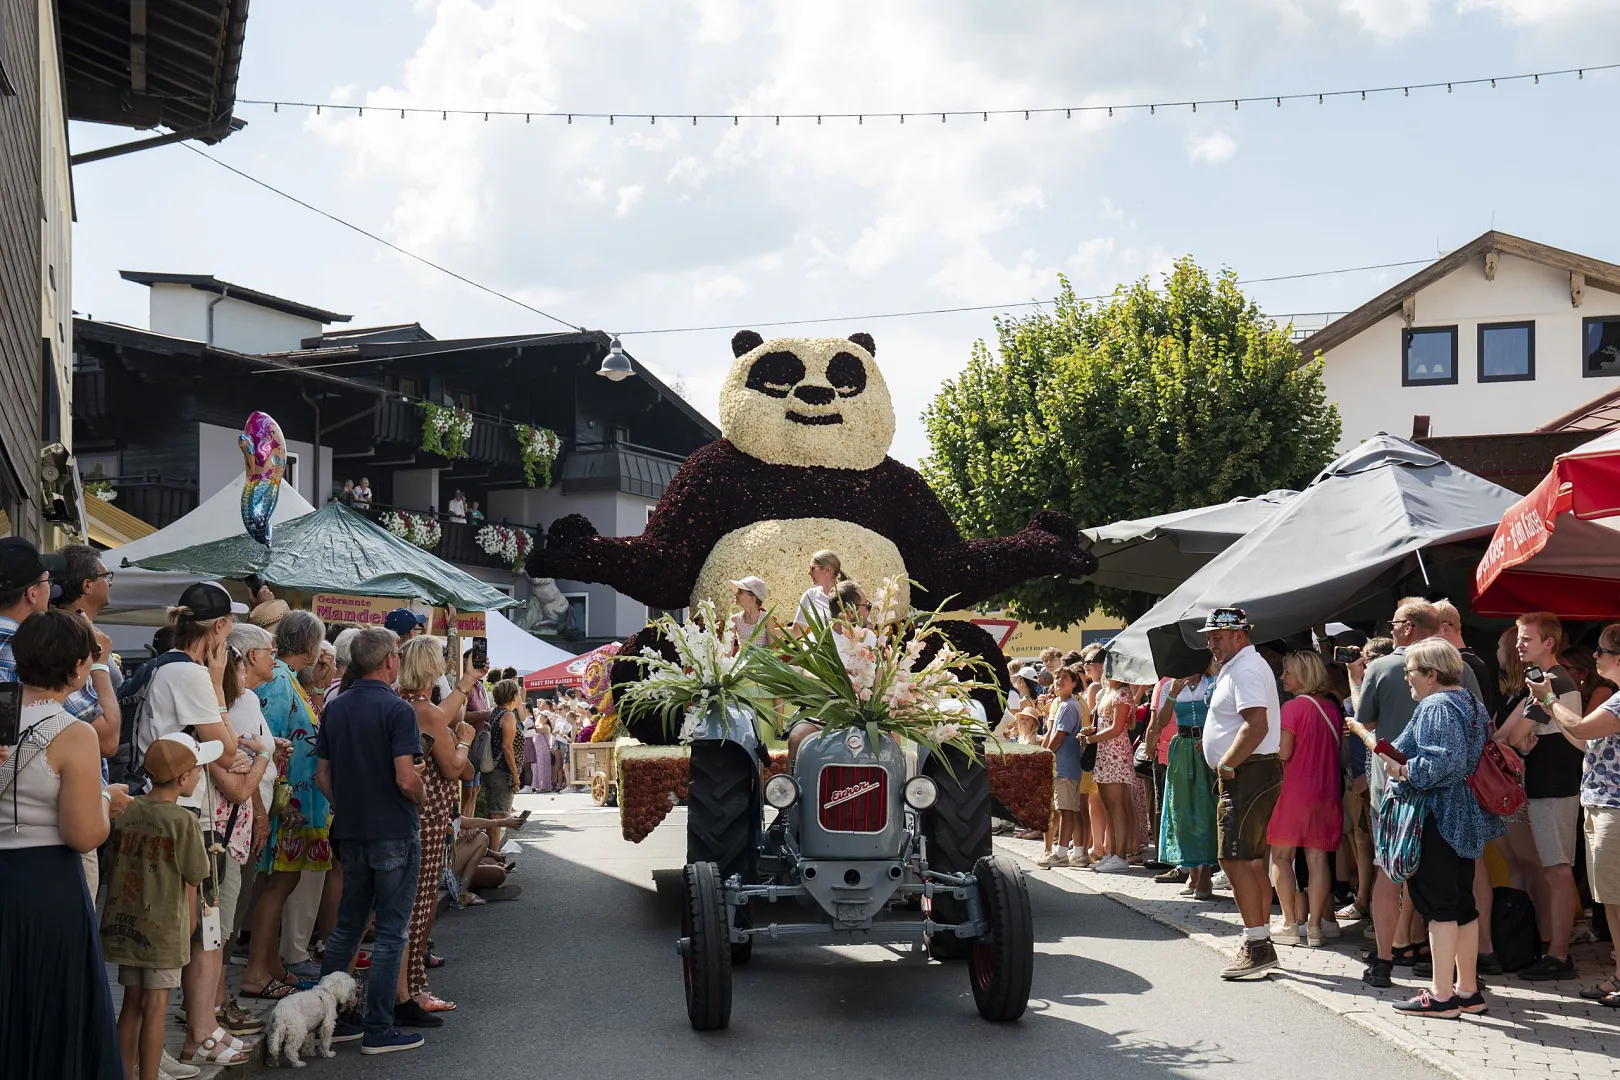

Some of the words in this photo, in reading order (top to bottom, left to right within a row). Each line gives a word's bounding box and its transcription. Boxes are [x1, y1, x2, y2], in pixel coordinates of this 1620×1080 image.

[1520, 507, 1543, 538] Kaiser
[317, 595, 372, 607] Gebrannte
[316, 605, 388, 625] Mandel
[831, 781, 870, 803] Eicher
[114, 912, 138, 927] TOUR
